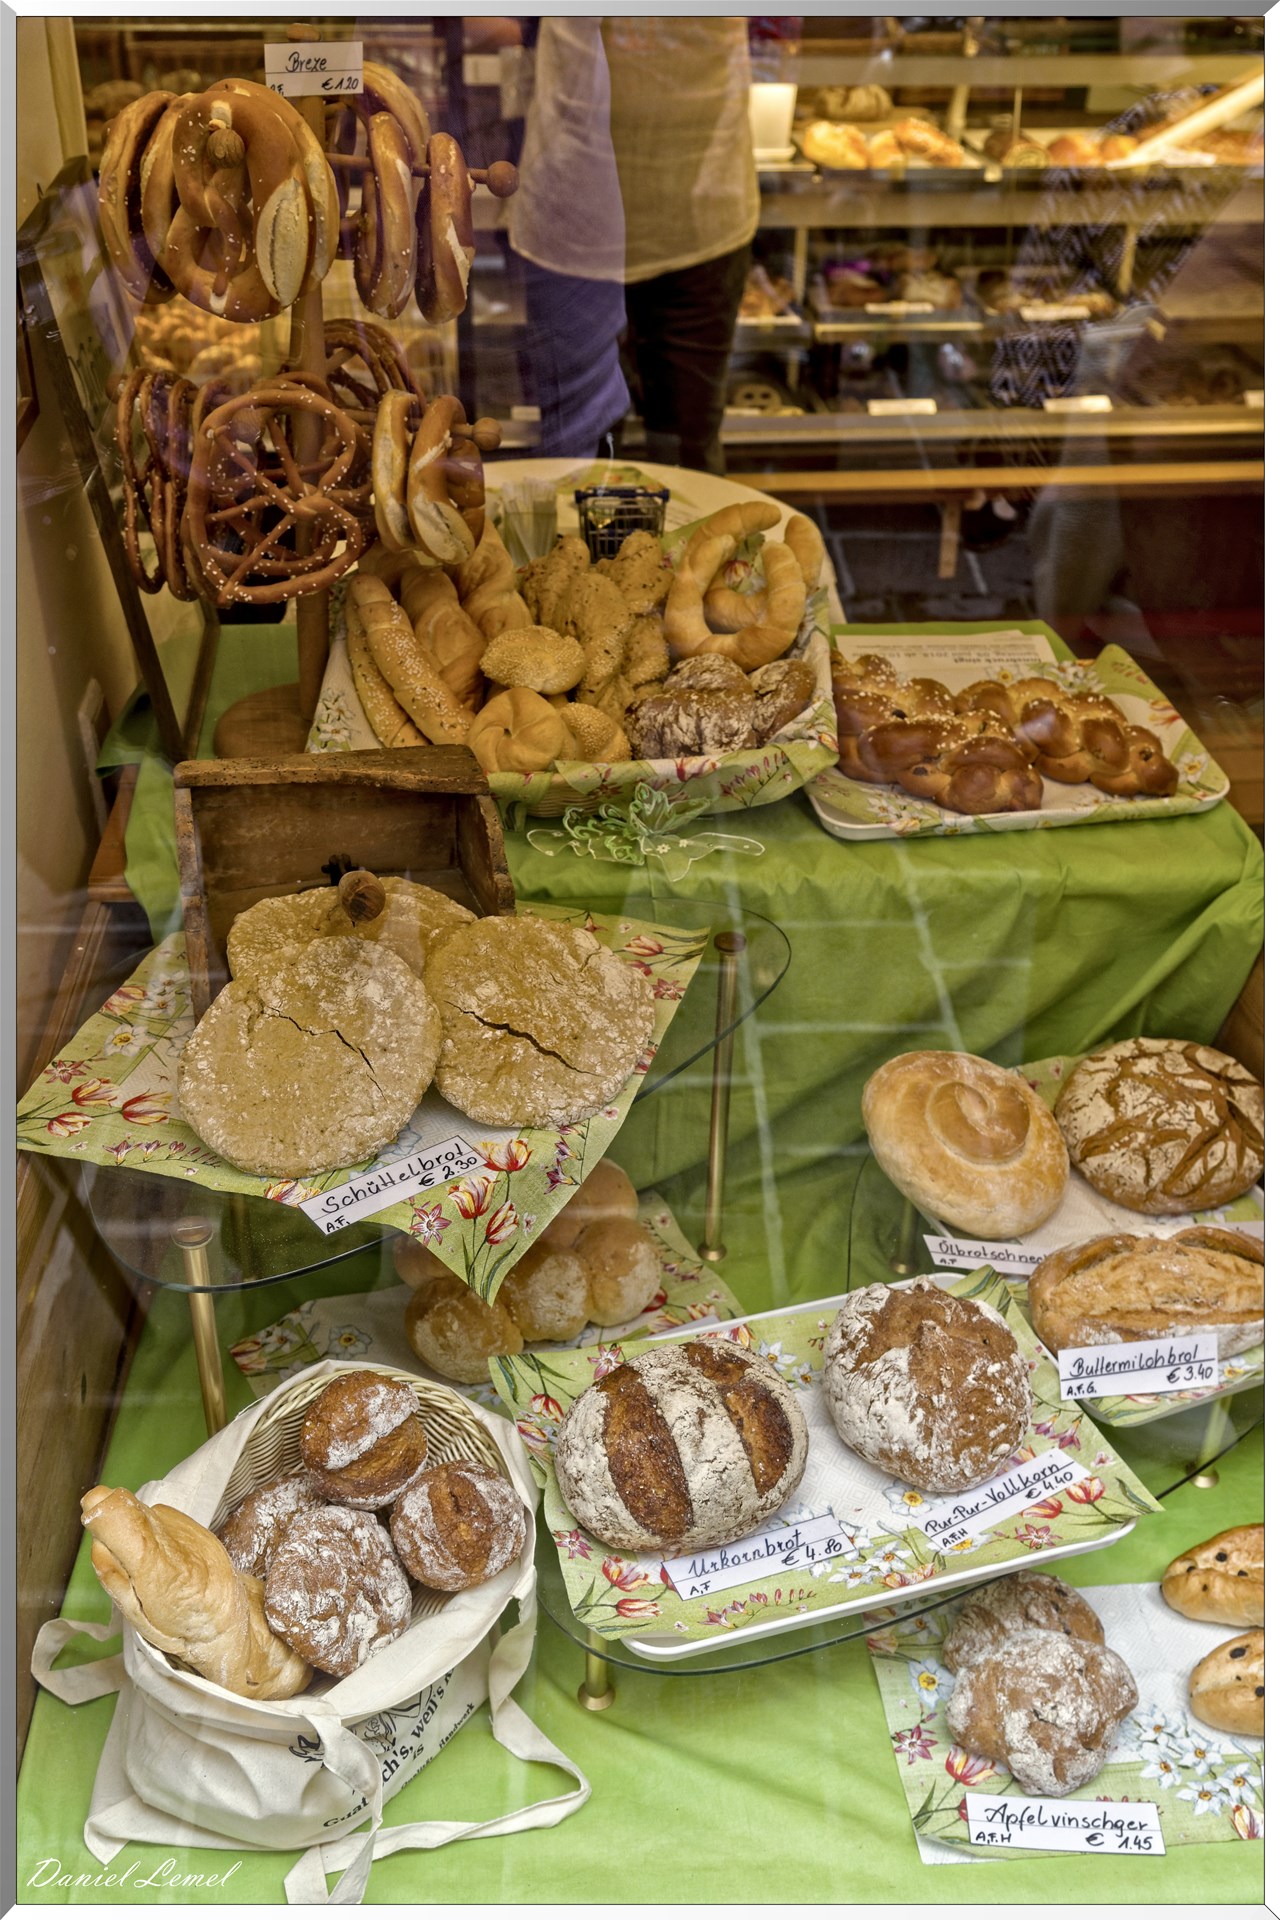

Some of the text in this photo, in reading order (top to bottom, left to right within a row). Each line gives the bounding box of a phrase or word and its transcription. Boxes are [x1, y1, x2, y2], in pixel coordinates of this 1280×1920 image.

[321, 1143, 463, 1214] Schüttelbrot
[442, 1156, 478, 1180] 2.30
[1183, 1363, 1213, 1381] 3.40
[1043, 1471, 1073, 1492] 4.40
[925, 1463, 1060, 1533] Pur-Pur-Vollkorn
[688, 1529, 806, 1577] Urkornbrot
[806, 1538, 842, 1559] 4.80
[1118, 1835, 1154, 1851] 1.45
